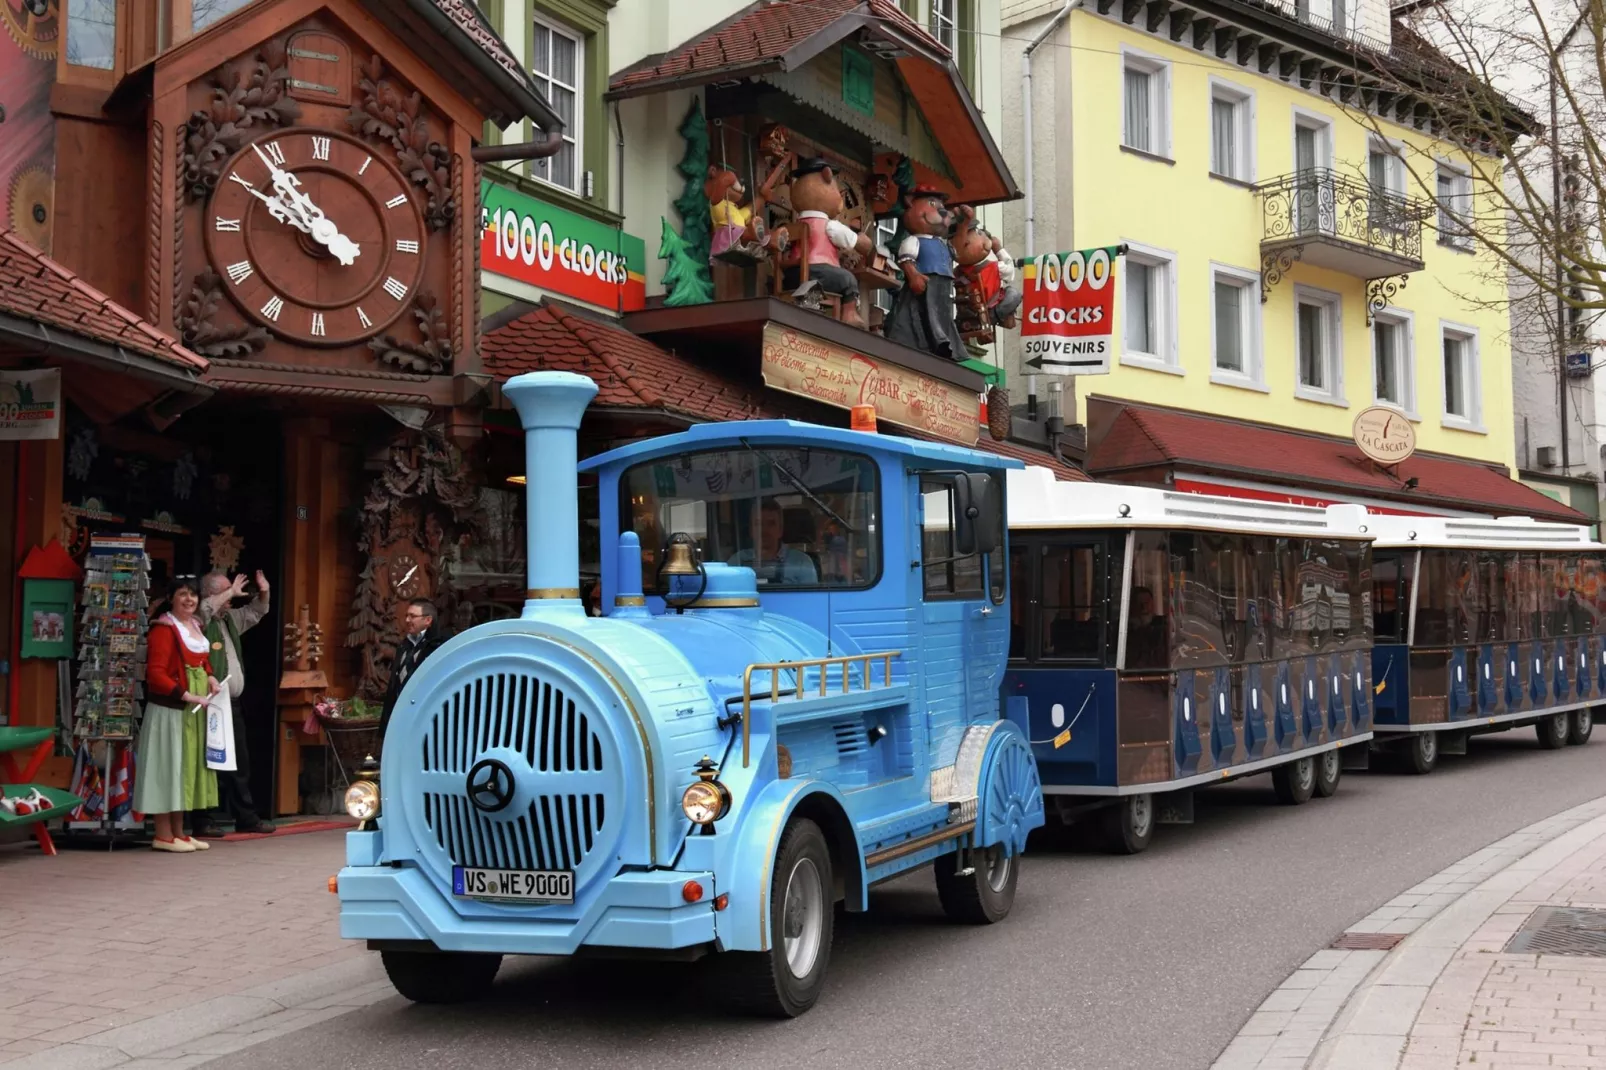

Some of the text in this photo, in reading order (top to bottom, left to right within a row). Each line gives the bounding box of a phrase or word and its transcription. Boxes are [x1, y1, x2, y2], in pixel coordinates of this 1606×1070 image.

[265, 141, 286, 166] XI
[312, 136, 330, 161] XII
[229, 171, 253, 191] X
[385, 193, 408, 209] II
[216, 216, 240, 232] IX
[396, 239, 419, 254] III
[493, 206, 555, 271] 1000
[559, 237, 628, 285] CLOCKS
[226, 260, 253, 285] VIII
[1033, 249, 1111, 292] 1000
[383, 276, 408, 301] IIII
[261, 295, 284, 321] VII
[356, 306, 372, 329] V
[1028, 305, 1104, 325] CLOCKS
[311, 312, 326, 336] VI
[1025, 340, 1105, 354] SOUVENIRS
[465, 870, 487, 893] VS
[525, 873, 570, 896] 9000
